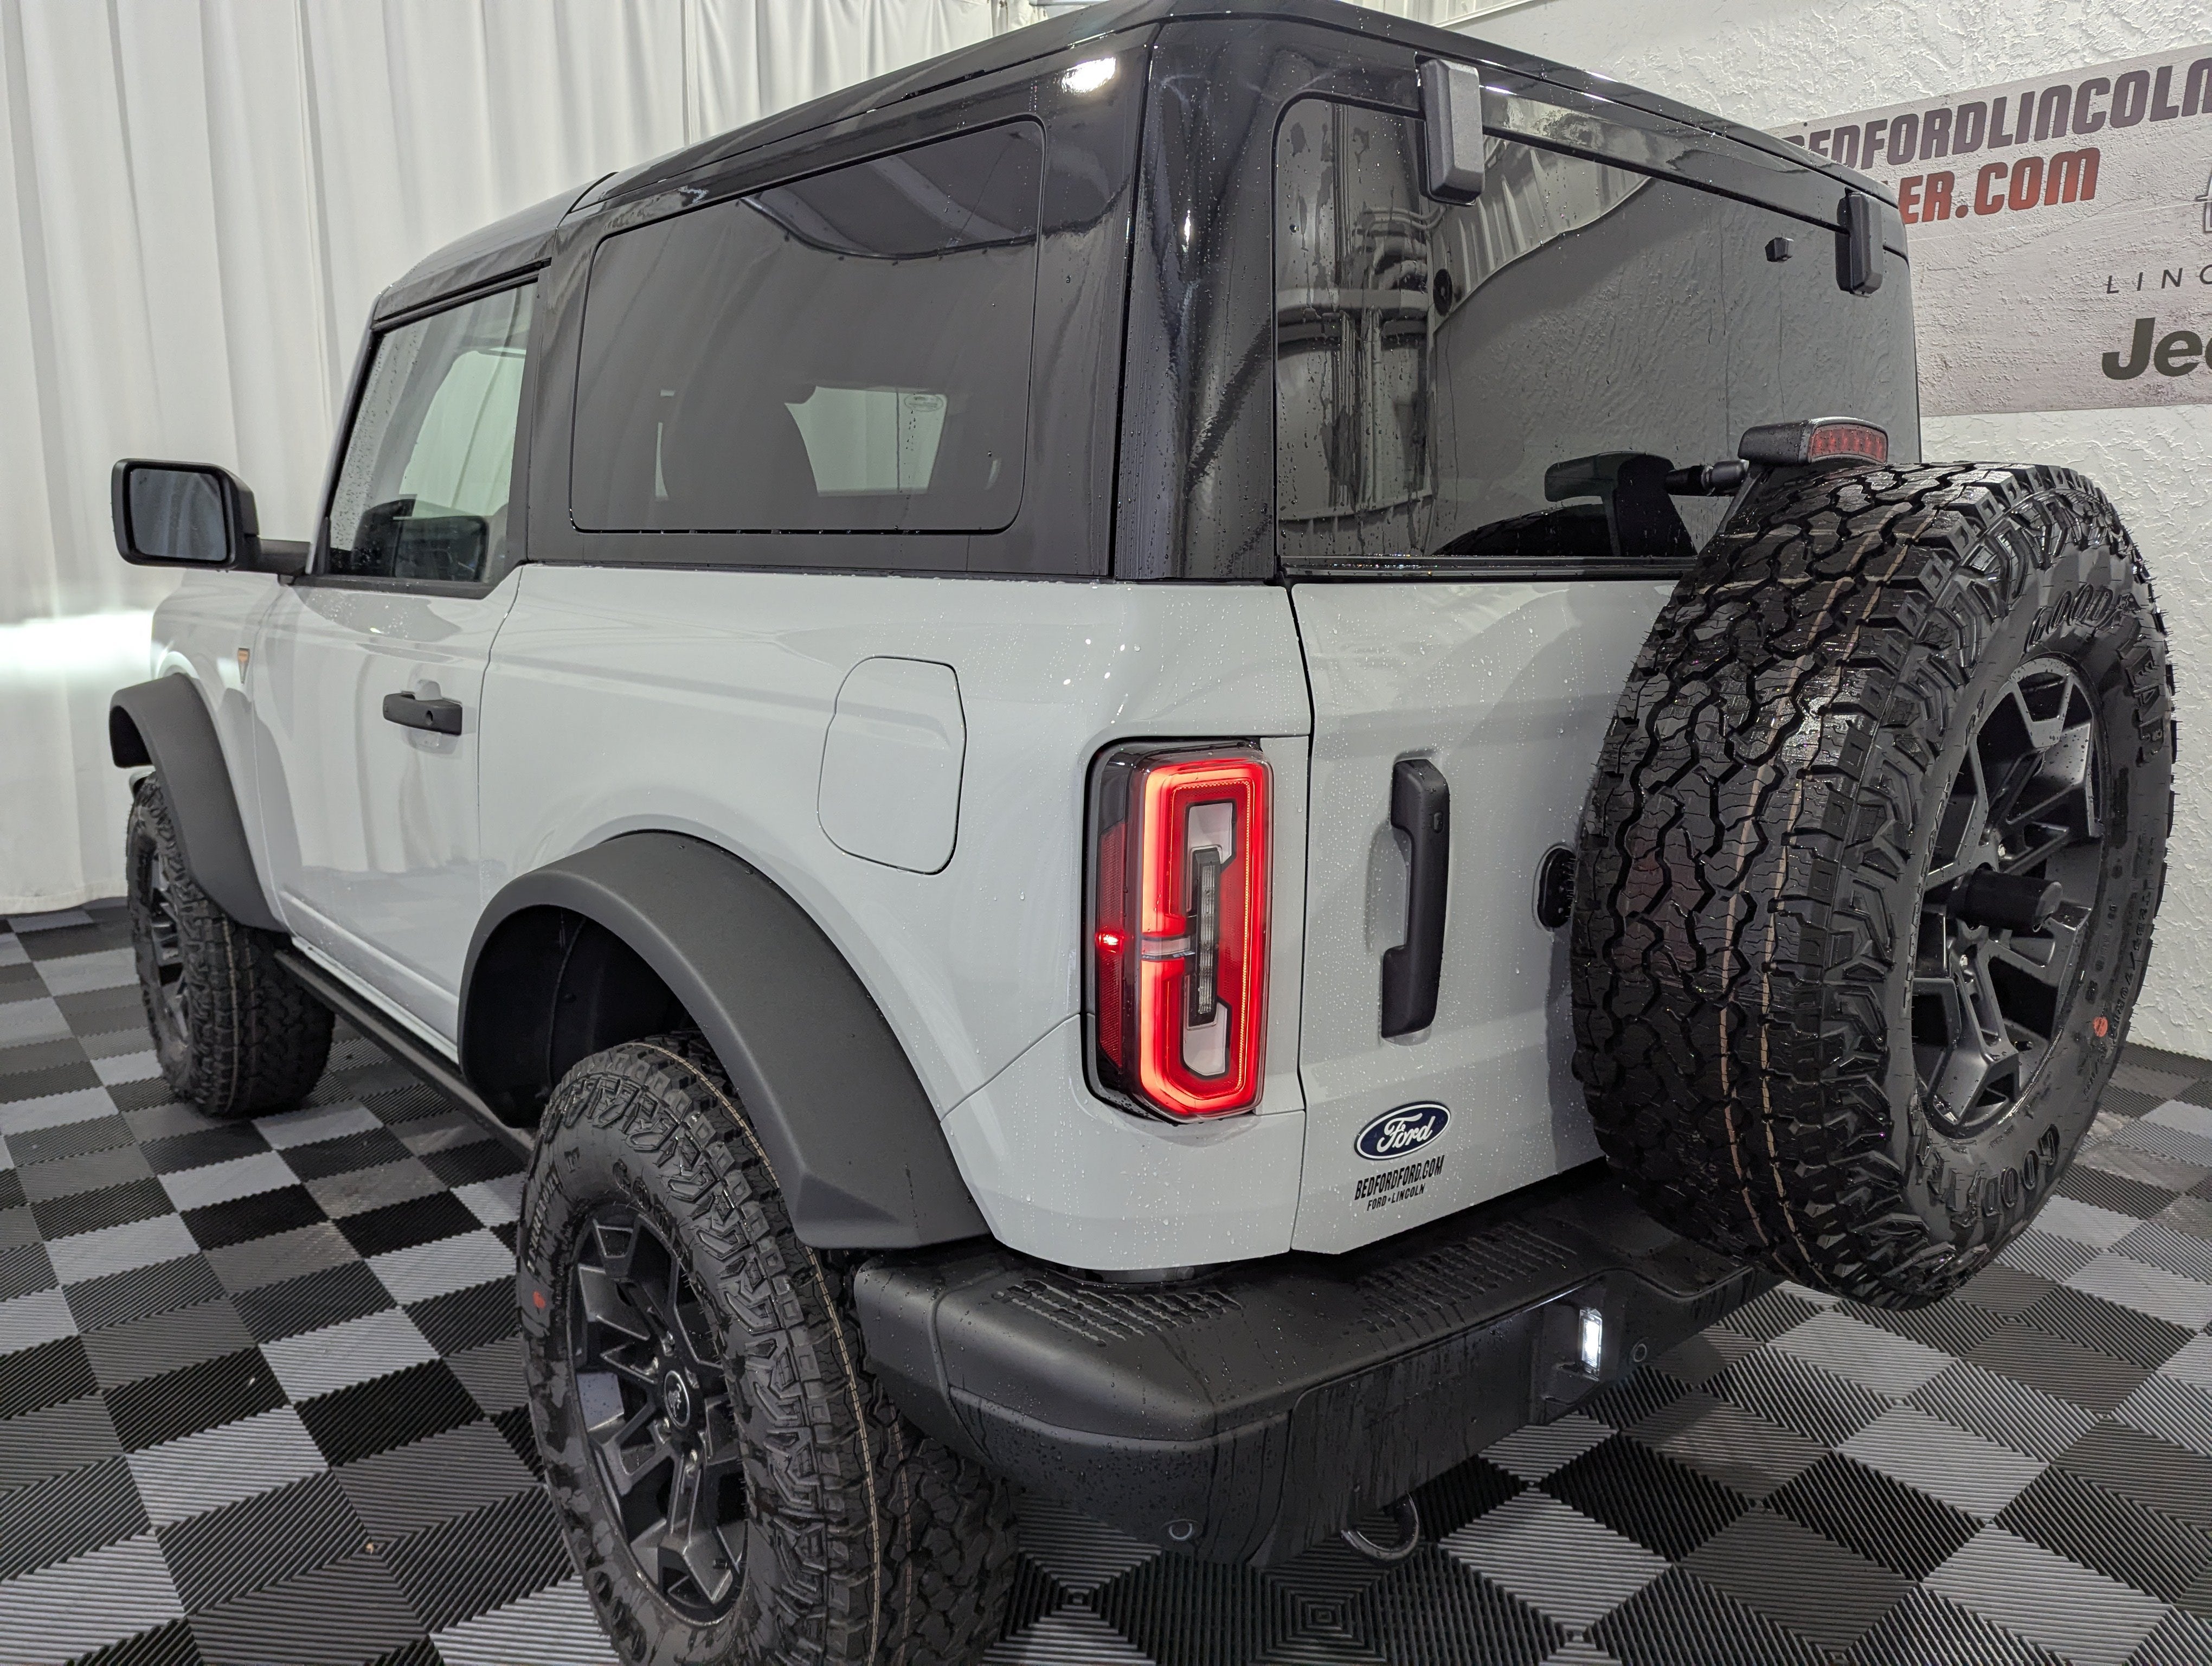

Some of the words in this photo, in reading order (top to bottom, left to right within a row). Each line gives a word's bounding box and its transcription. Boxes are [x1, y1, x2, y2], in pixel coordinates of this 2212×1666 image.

[1782, 57, 2212, 170] DFORDLINCOLN
[1883, 146, 2100, 225] ER.COM
[2101, 317, 2212, 381] Je
[1377, 1112, 1436, 1153] Ford
[1354, 1155, 1445, 1201] BEDFORDFORD.COM
